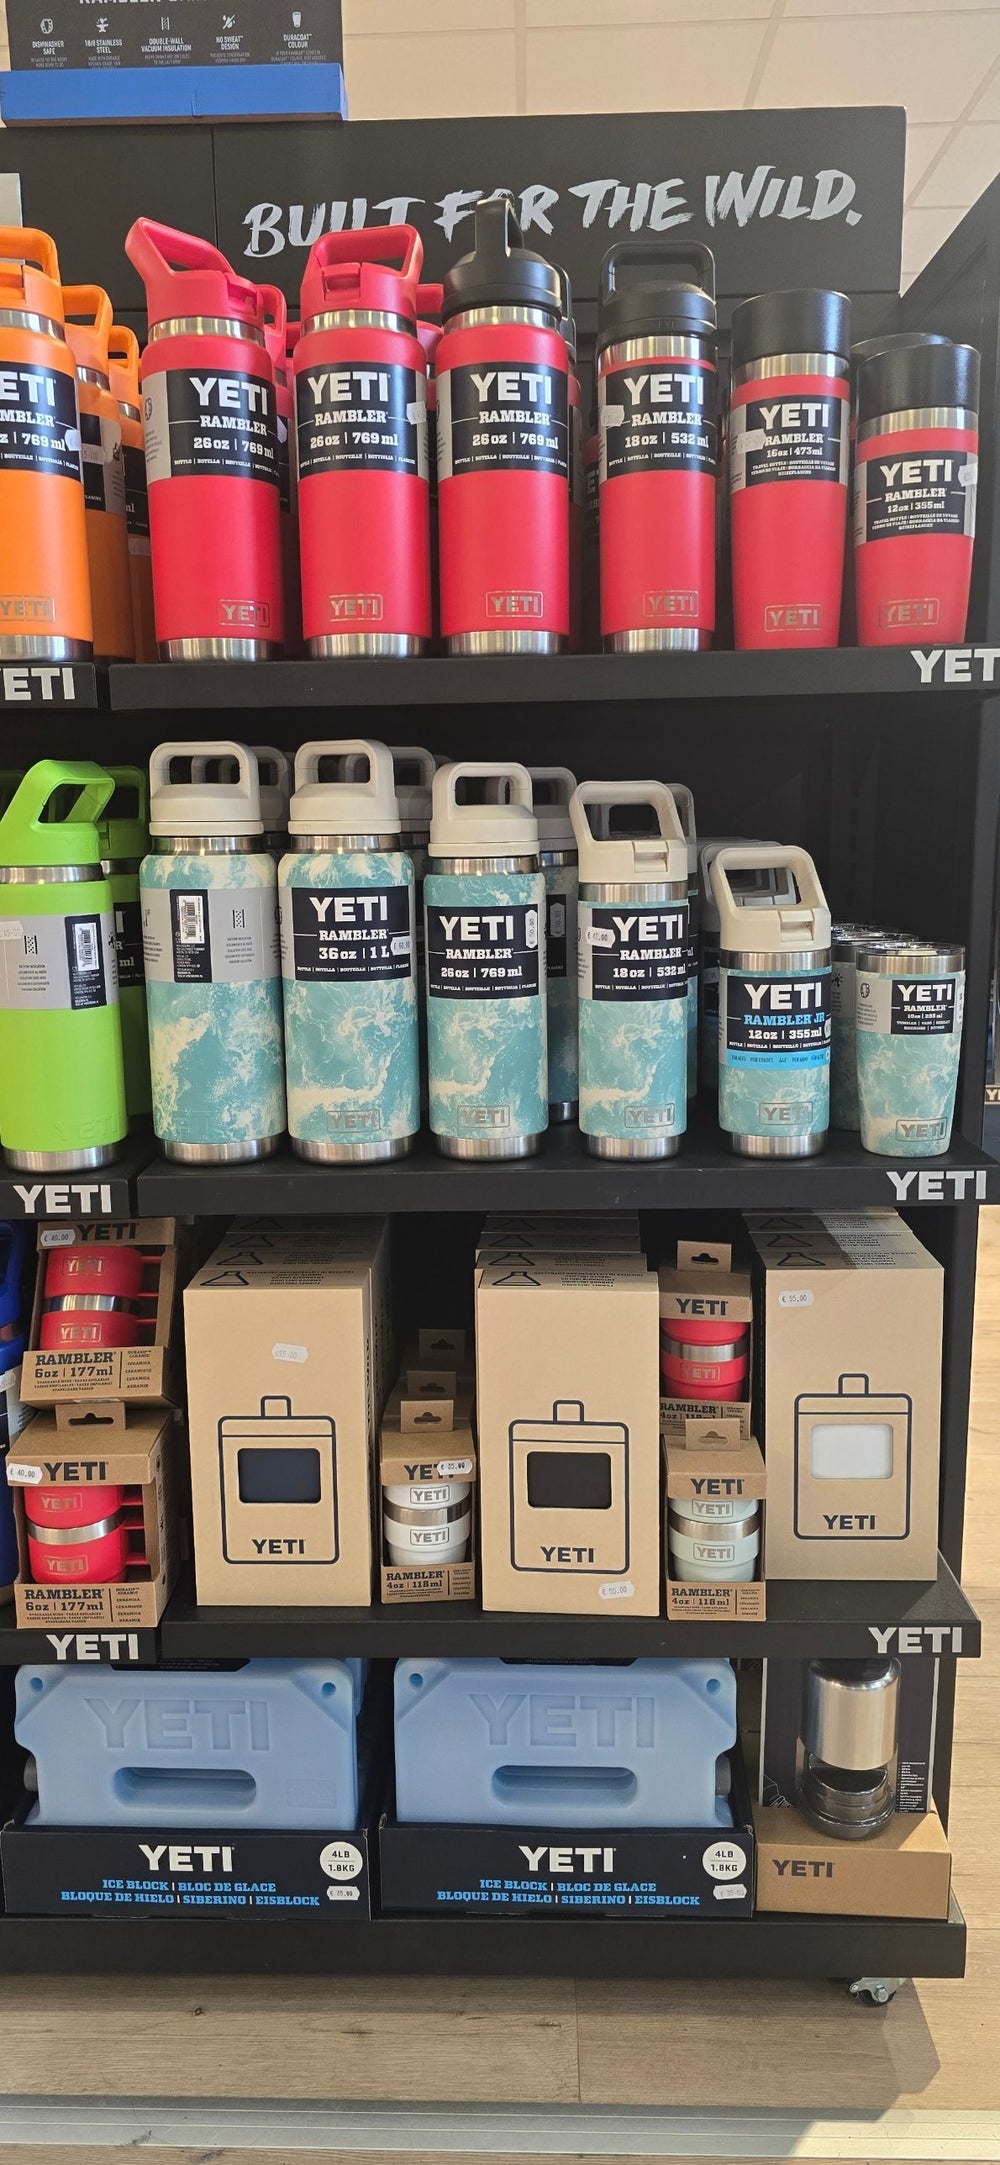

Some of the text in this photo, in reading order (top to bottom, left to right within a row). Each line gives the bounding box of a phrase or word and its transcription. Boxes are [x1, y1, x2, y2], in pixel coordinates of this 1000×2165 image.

[96, 46, 111, 54] STEEL
[162, 44, 192, 52] INSULATION
[434, 184, 559, 241] FR
[568, 178, 693, 231] THE
[706, 165, 863, 227] WILD.
[0, 371, 55, 407] ETI
[308, 371, 389, 405] YETI
[470, 372, 552, 405] YETI
[624, 374, 704, 405] YETI
[189, 377, 268, 416] YETI
[315, 410, 386, 426] RAMBLER
[479, 410, 550, 426] RAMBLER
[632, 411, 703, 427] RAMBLER
[759, 403, 829, 430] YETI
[200, 415, 267, 436] RAMBLER
[765, 433, 824, 446] RAMBLER
[880, 459, 952, 487] YETI
[885, 488, 946, 503] RAMBLER
[330, 599, 378, 616] YETI
[490, 596, 539, 613] YETI
[648, 597, 694, 612] YETI
[886, 603, 934, 622] YETI
[222, 604, 267, 622] YETI
[768, 609, 818, 626] YETI
[910, 649, 1000, 683] YET
[0, 667, 76, 700] ETI
[309, 896, 388, 922] YETI
[319, 928, 387, 941] RAMBLER
[439, 916, 514, 941] YETI
[612, 914, 683, 942] YETI
[446, 948, 512, 960] RAMBLER
[620, 947, 682, 960] RAMBLER
[744, 982, 822, 1010] YETI
[898, 984, 952, 1002] YETI
[744, 1012, 825, 1026] RAMBLER JR
[330, 1113, 377, 1131] YETI
[463, 1110, 505, 1124] YETI
[630, 1106, 671, 1124] YETI
[900, 1122, 945, 1137] YETI
[886, 1171, 987, 1201] YETI
[13, 1184, 112, 1214] YETI
[77, 1222, 137, 1241] YETI
[67, 1260, 102, 1272] YETI
[676, 1298, 727, 1316] YETI
[61, 1327, 97, 1340] YETI
[35, 1352, 114, 1366] RAMBLER
[35, 1365, 113, 1378] 6oz 177ml
[683, 1368, 717, 1379] YETI
[660, 1403, 716, 1414] RAMBLER
[44, 1462, 106, 1481] YETI
[690, 1478, 743, 1495] YETI
[41, 1497, 78, 1508] YETI
[413, 1489, 447, 1502] YETI
[694, 1502, 730, 1514] YETI
[823, 1515, 876, 1530] YETI
[413, 1531, 446, 1543] YETI
[252, 1539, 305, 1554] YETI
[540, 1546, 594, 1563] YETI
[696, 1547, 731, 1558] YETI
[46, 1559, 83, 1572] YETI
[387, 1571, 443, 1581] RAMBLER
[412, 1580, 442, 1588] 118ml
[25, 1589, 104, 1600] RAMBLER
[672, 1588, 730, 1597] RAMBLER
[26, 1602, 104, 1611] 6oz 177ml
[46, 1633, 139, 1660] YETI
[868, 1627, 962, 1654] YETI
[84, 1698, 270, 1751] YETI
[468, 1693, 655, 1748] YETI
[138, 1844, 233, 1872] YETI
[332, 1850, 351, 1858] 4LB
[519, 1845, 614, 1873] YETI
[715, 1850, 734, 1858] 4LB
[328, 1864, 355, 1873] 1.8KG
[710, 1863, 738, 1872] 1.8KG
[772, 1860, 833, 1878] YETI
[102, 1880, 276, 1892] ICE BLOCK BLOC DE GLACE
[480, 1880, 656, 1892] ICE BLOCK BLOC DE GLACE
[61, 1891, 320, 1906] BLOQUE DE HIELO SIBERINO EISBLOCK
[437, 1891, 700, 1906] BLOQUE DE HIELO SIBERINO EISBLOCK
